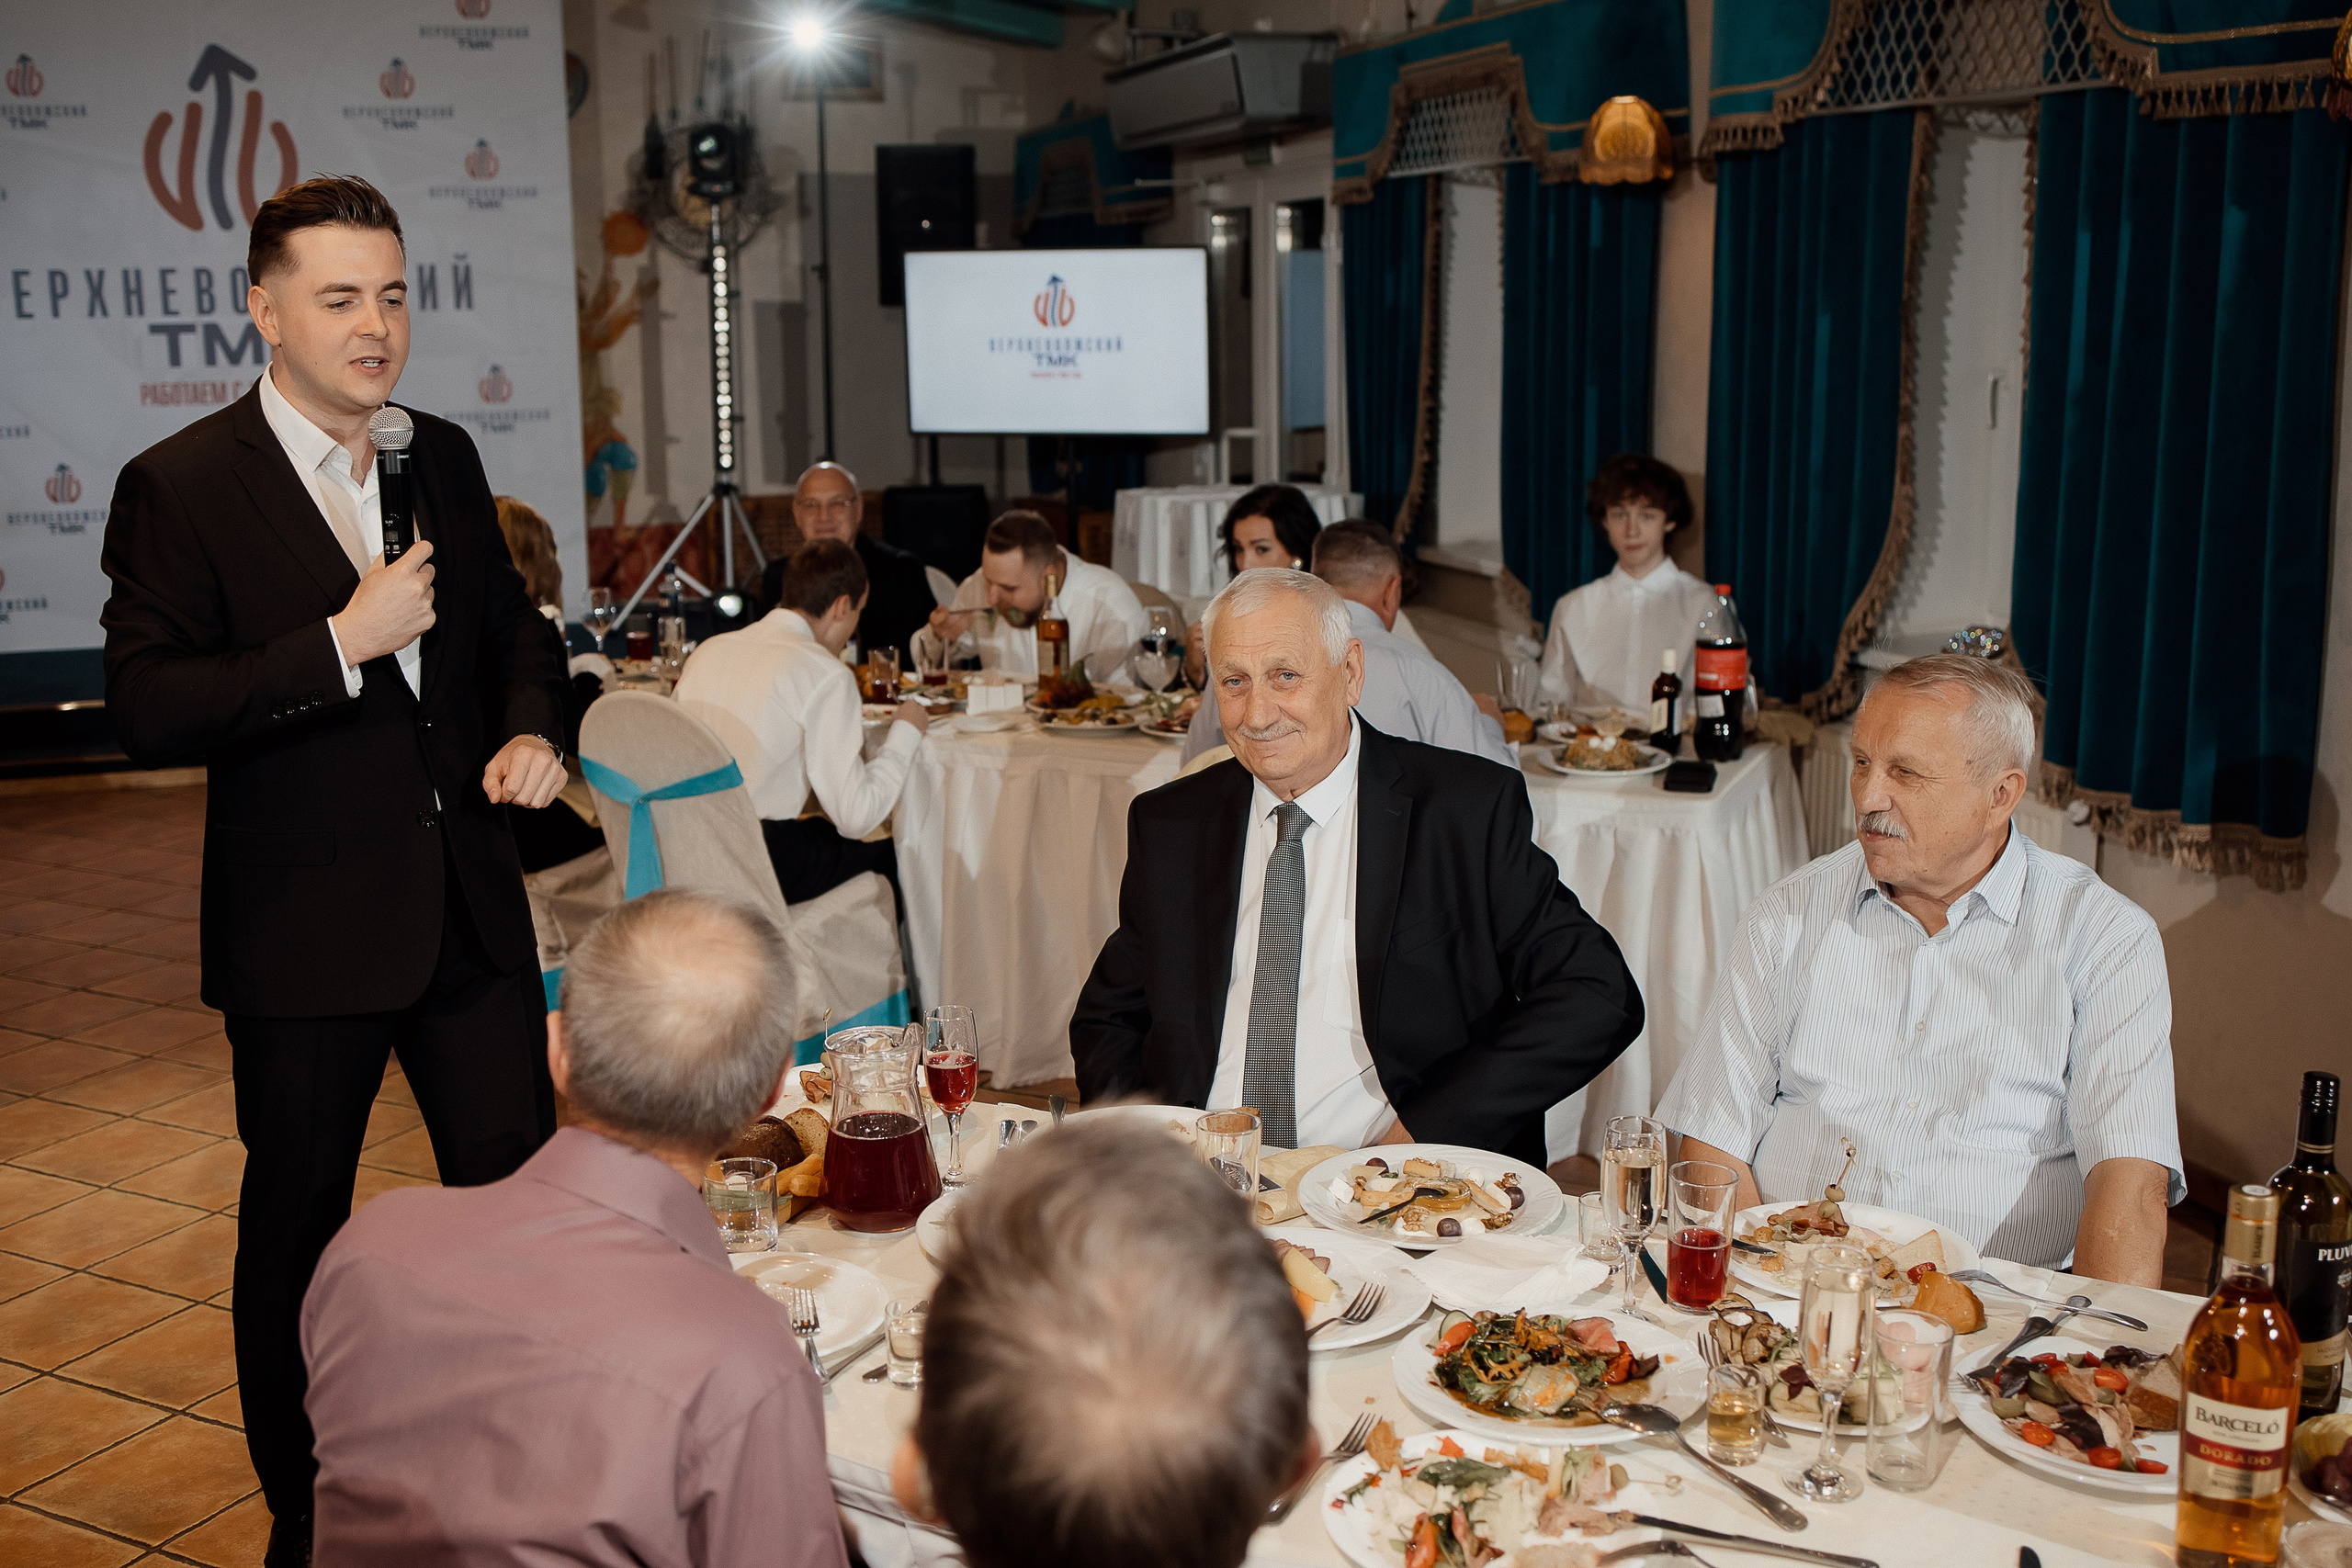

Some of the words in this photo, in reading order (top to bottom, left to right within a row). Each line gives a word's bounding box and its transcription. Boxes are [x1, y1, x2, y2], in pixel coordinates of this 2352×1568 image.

[149, 323, 265, 367] ТМ
[2318, 1244, 2352, 1261] PLUV
[2199, 1444, 2272, 1466] DORADO
